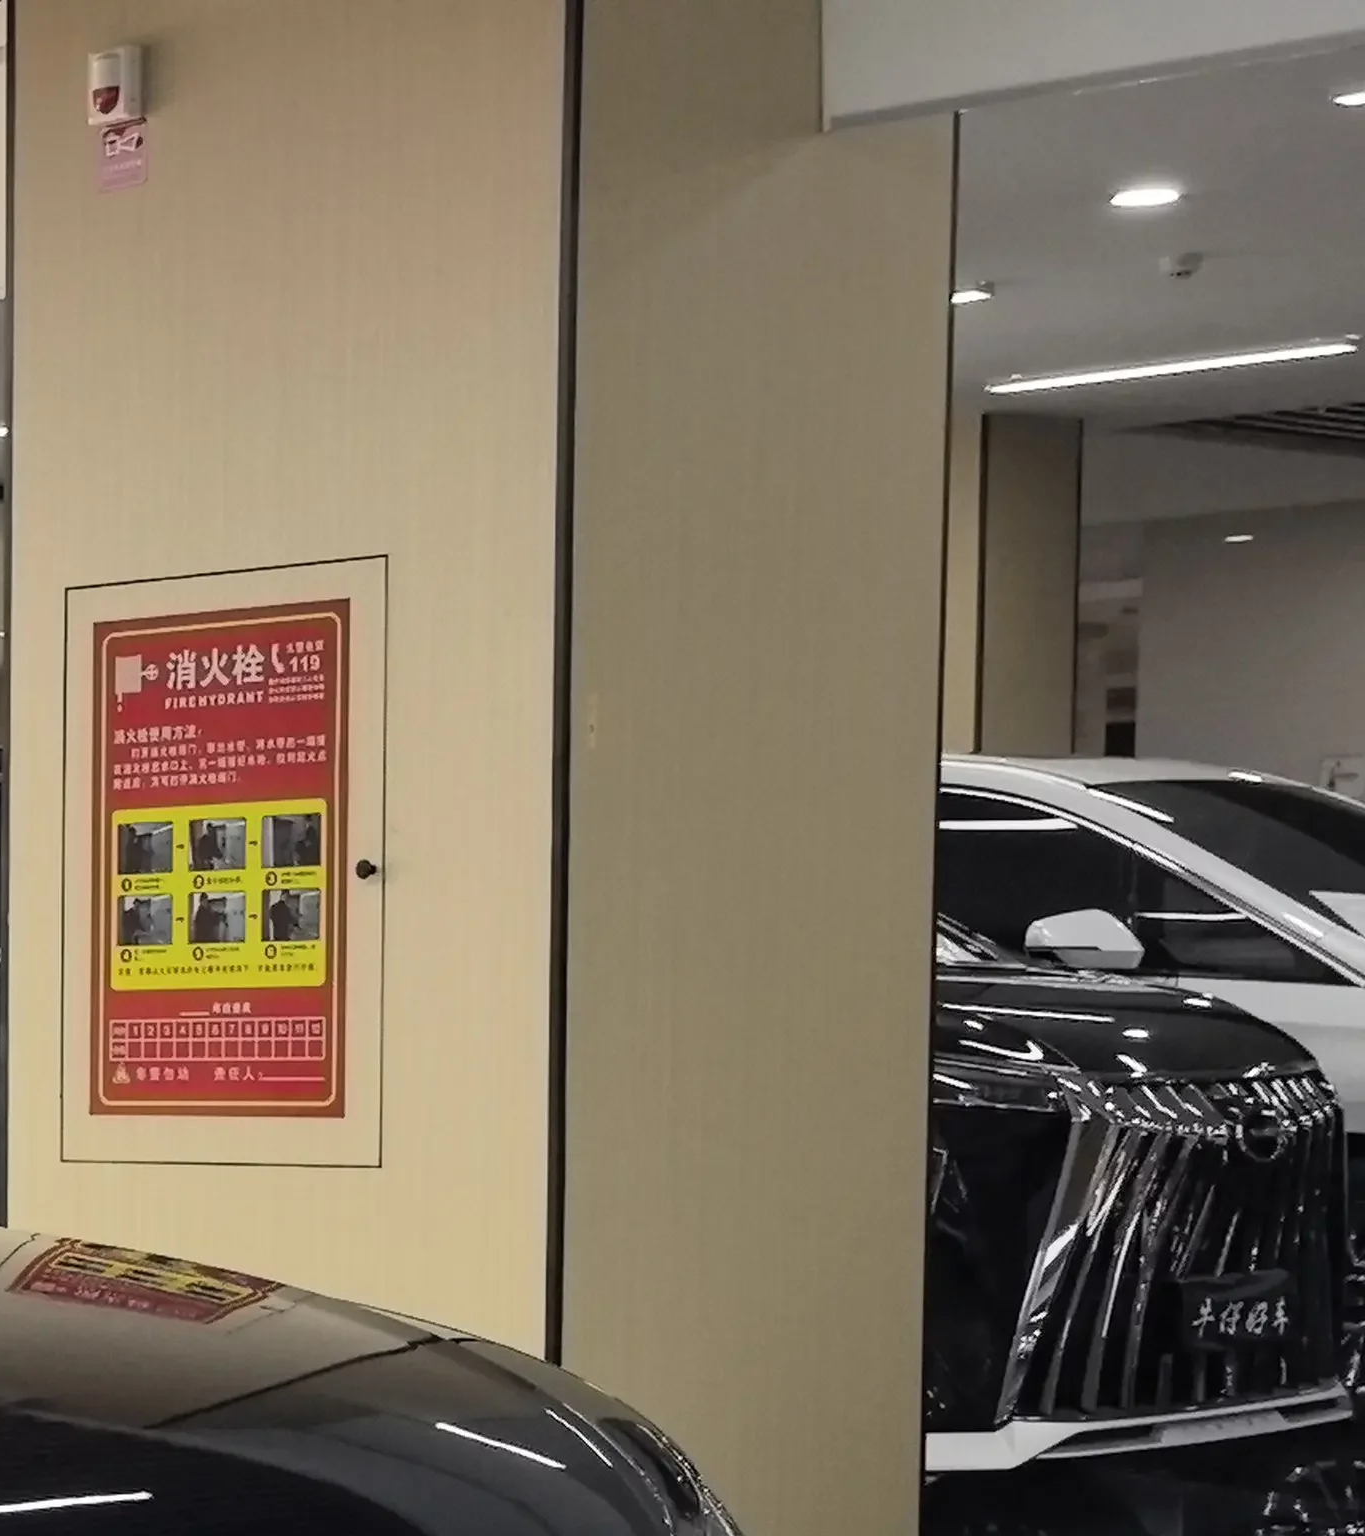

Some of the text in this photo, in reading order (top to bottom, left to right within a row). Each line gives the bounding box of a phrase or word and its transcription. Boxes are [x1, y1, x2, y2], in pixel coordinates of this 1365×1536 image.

[166, 644, 265, 690] 消火栓
[289, 655, 320, 673] 119
